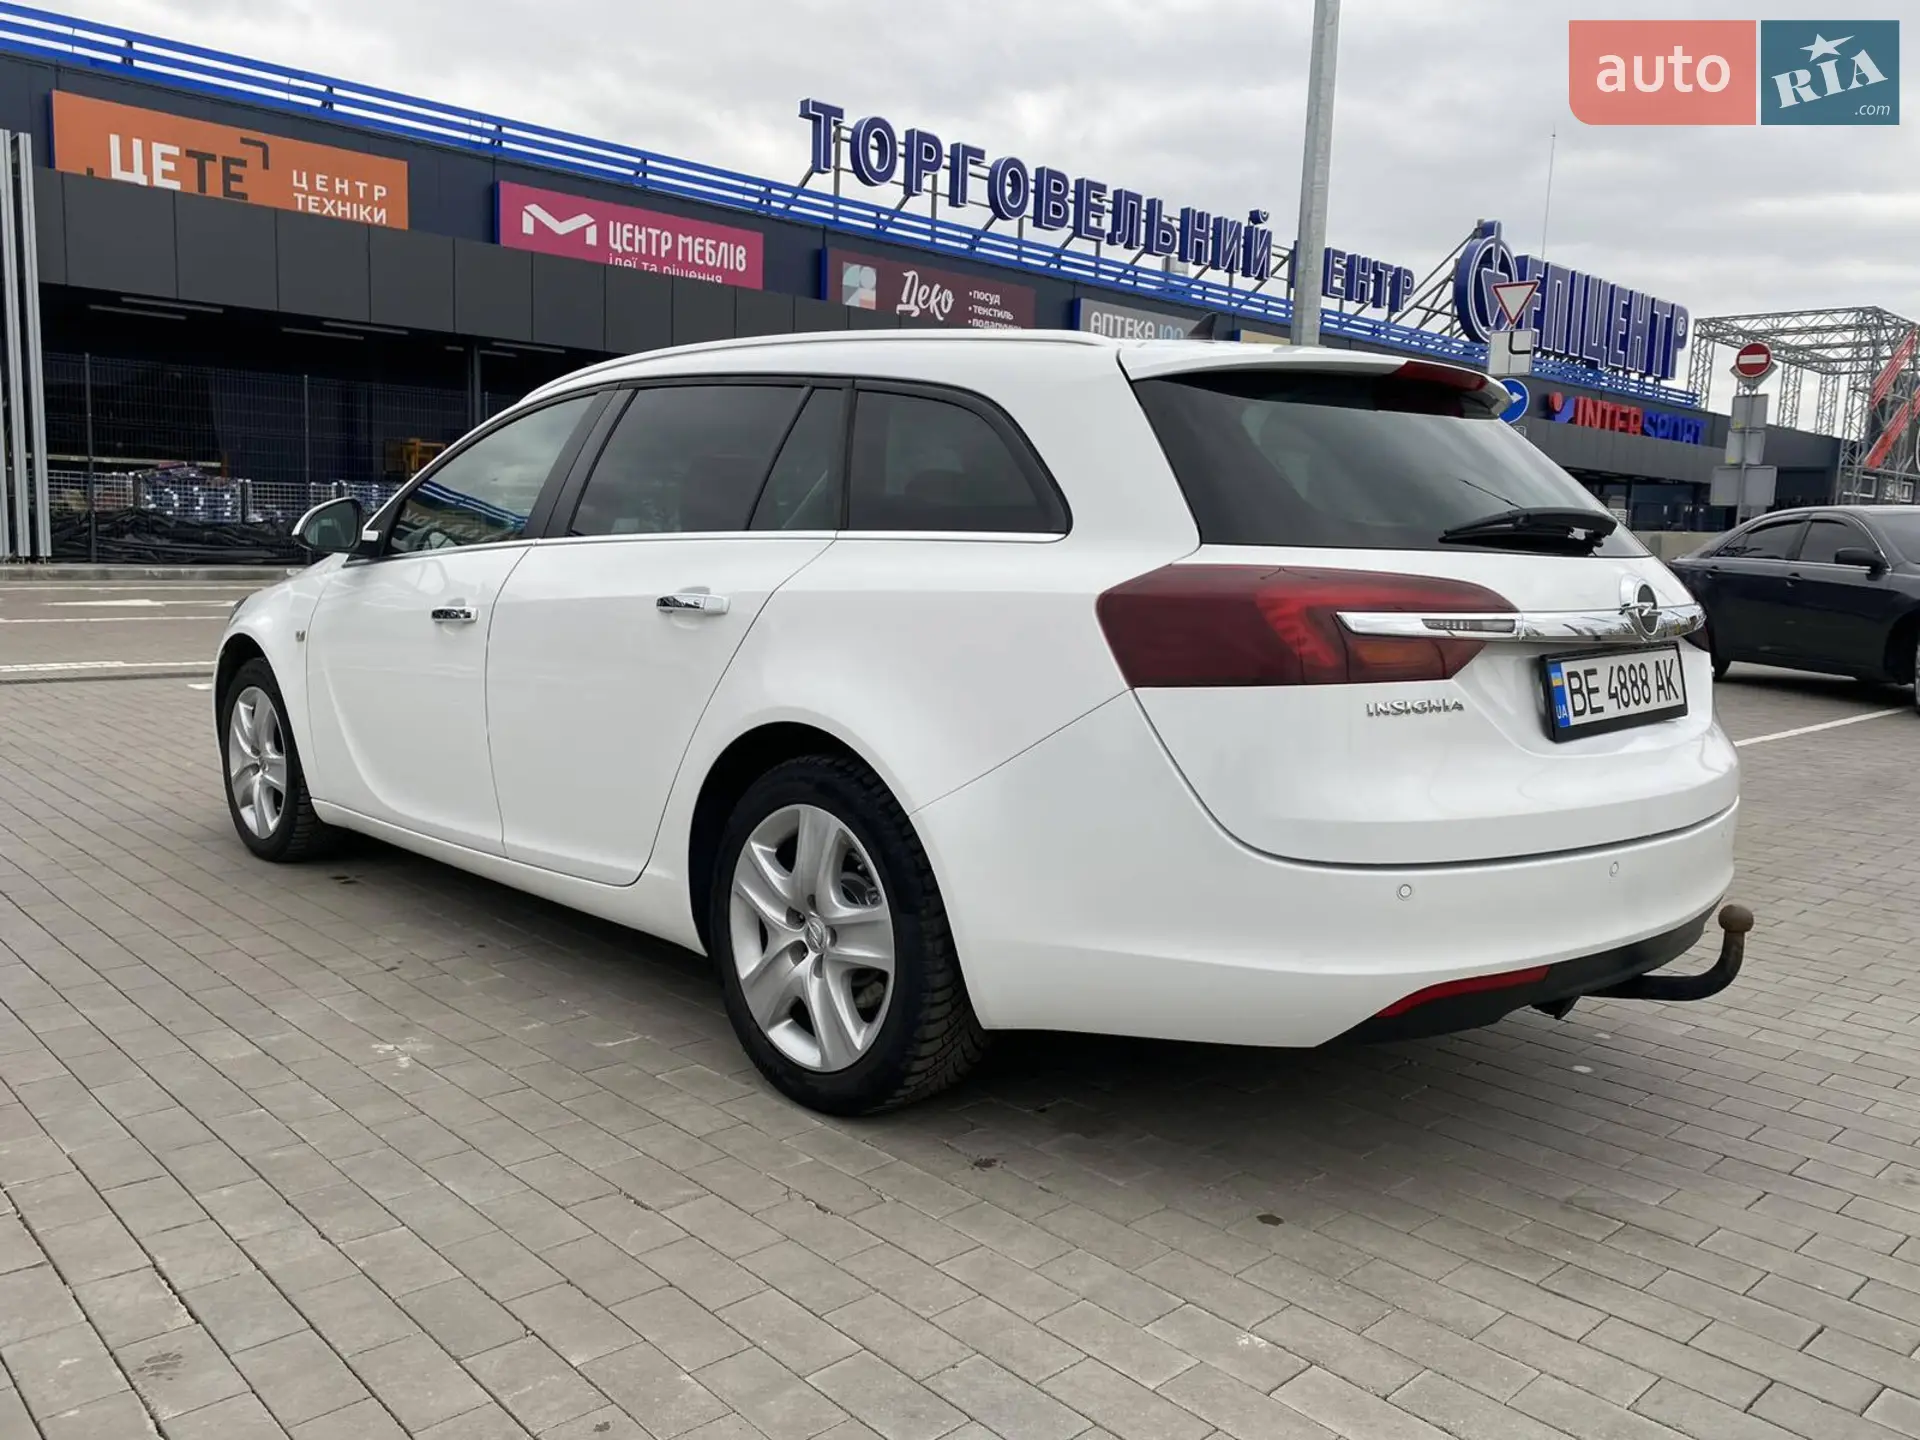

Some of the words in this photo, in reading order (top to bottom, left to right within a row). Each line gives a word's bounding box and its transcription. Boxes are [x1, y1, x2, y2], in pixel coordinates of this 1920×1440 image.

[109, 133, 249, 201] ЦЕТЕ
[292, 169, 389, 201] ЦЕНТР
[293, 191, 388, 225] ТЕХНІКИ
[799, 97, 1274, 280] ТОРГОВЕЛЬНИЙ
[1292, 239, 1416, 313] ЕНТР
[608, 220, 673, 258] ЦЕНТР
[677, 234, 747, 273] МЕБЛІВ
[895, 270, 955, 321] Деко
[972, 289, 1001, 306] посуд
[972, 304, 1014, 320] текстиль
[1089, 311, 1155, 340] АПТЕКА
[1515, 254, 1690, 382] ЕПІЦЕНТР
[1566, 668, 1605, 717] BE
[1607, 662, 1652, 710] 4888
[1654, 658, 1680, 703] AK
[1365, 697, 1465, 717] INSIGNIA
[1555, 704, 1569, 720] UA
